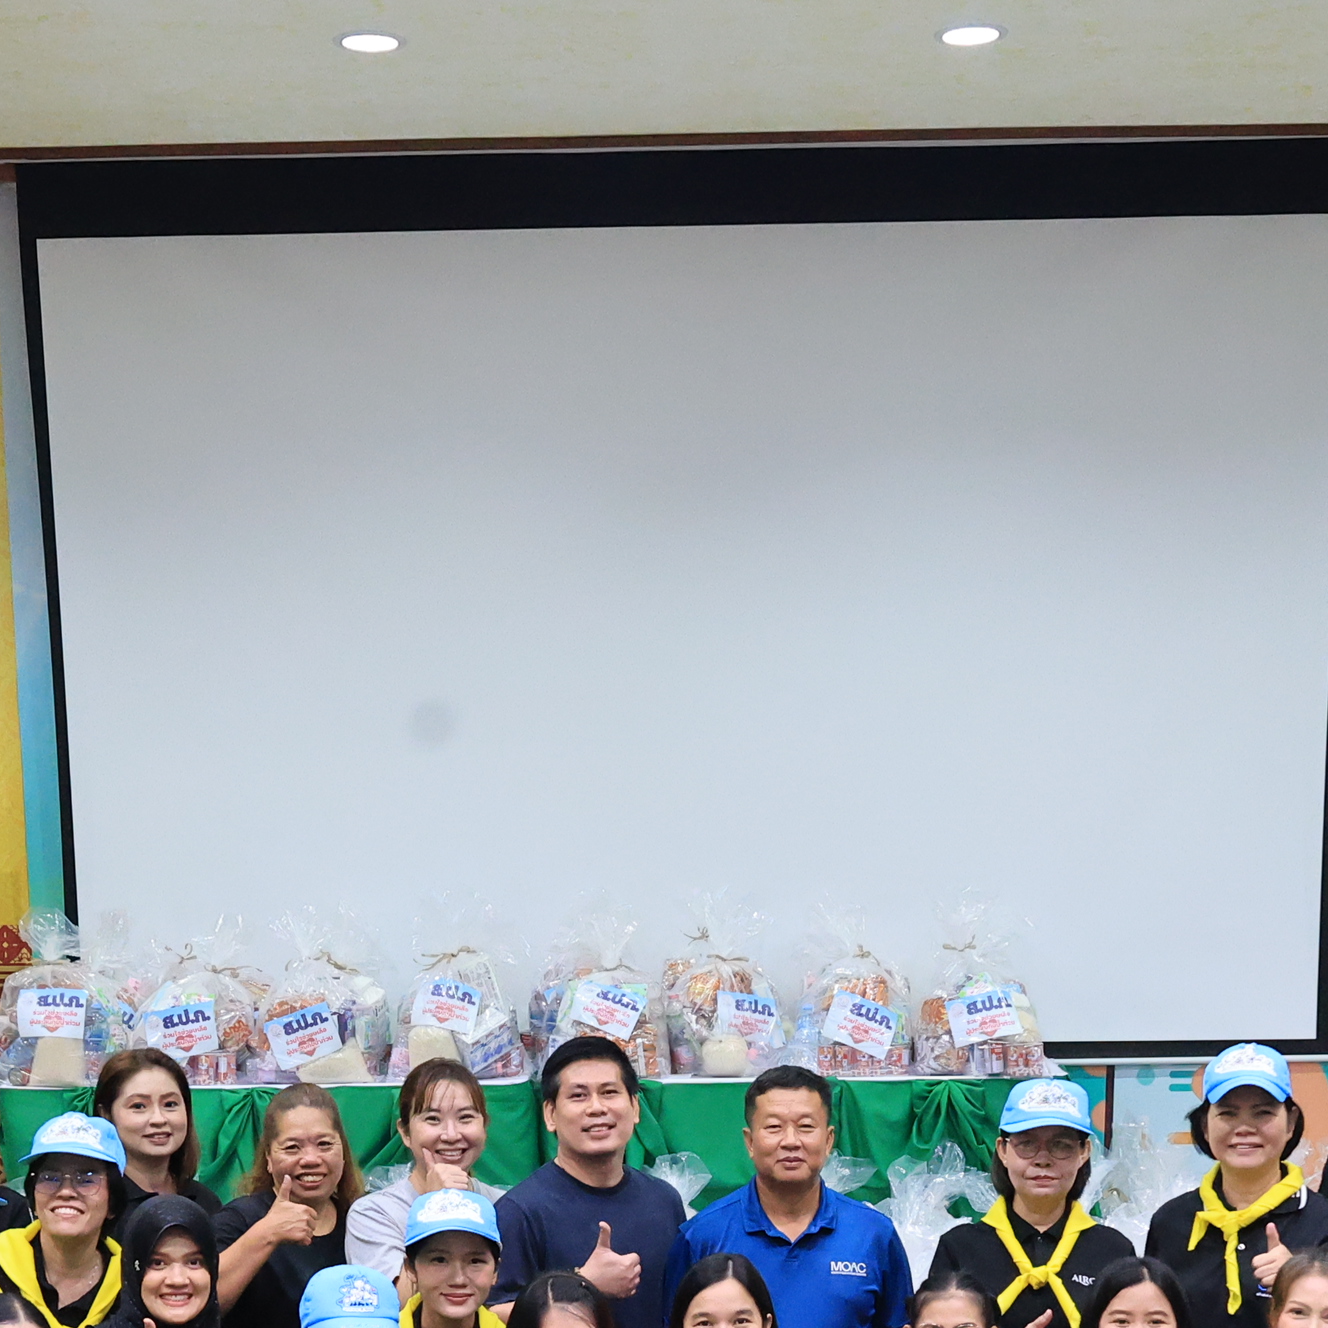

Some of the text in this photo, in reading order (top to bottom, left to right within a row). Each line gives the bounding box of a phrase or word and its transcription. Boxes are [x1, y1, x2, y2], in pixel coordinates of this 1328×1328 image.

[162, 1008, 212, 1030] ส.ป.ก.
[282, 1010, 329, 1036] ส.ป.ก.
[830, 1261, 867, 1273] MOAC
